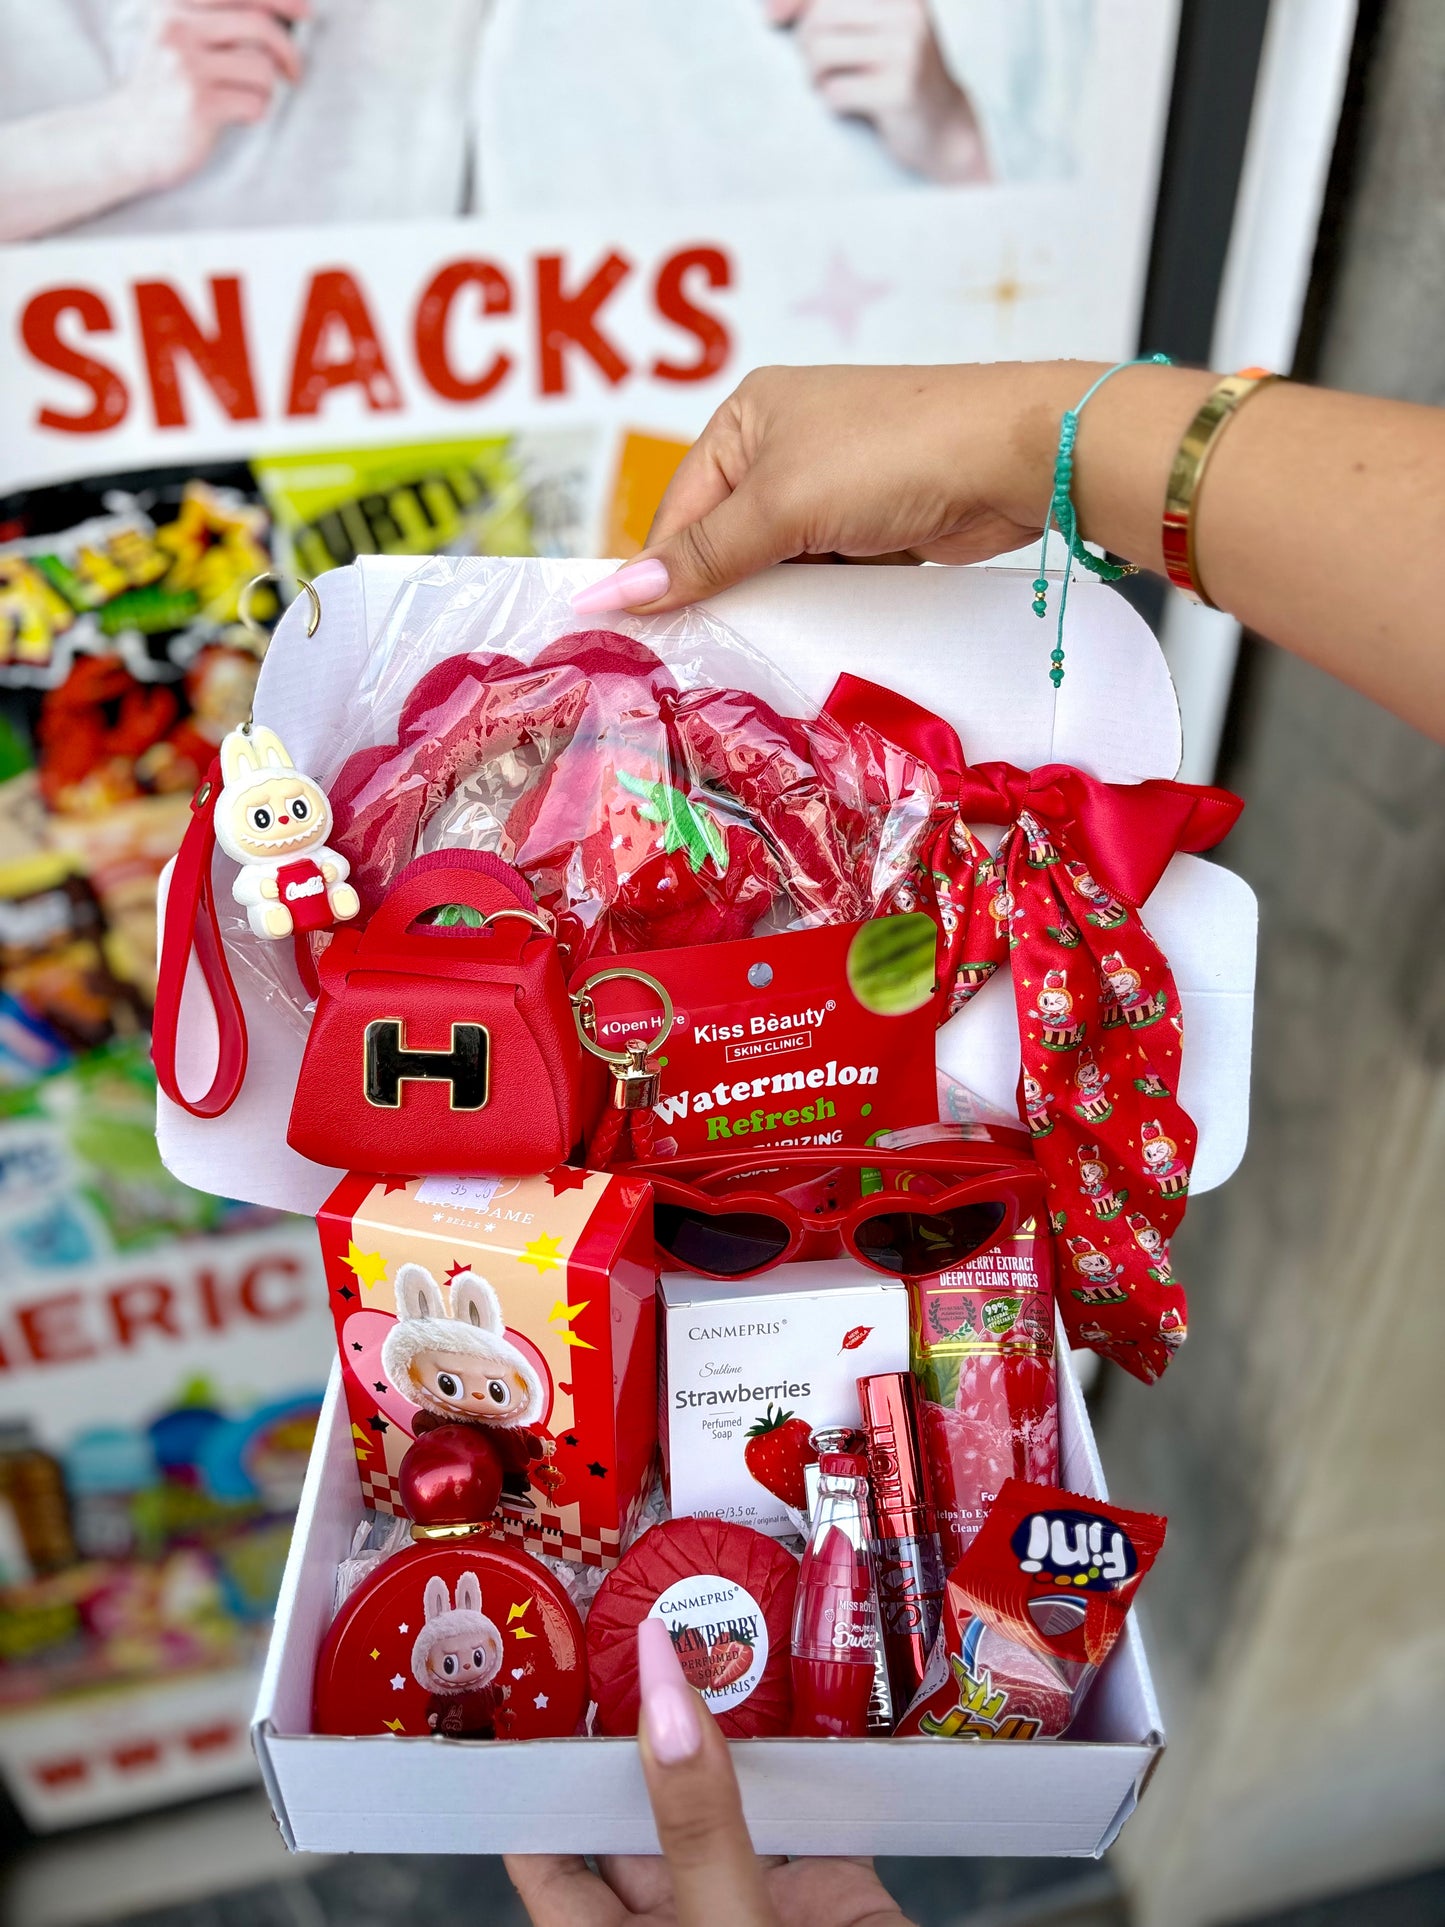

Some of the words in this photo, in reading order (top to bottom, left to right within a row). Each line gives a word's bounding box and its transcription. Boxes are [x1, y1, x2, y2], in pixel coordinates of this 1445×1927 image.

[20, 243, 737, 437] SNACKS
[609, 1020, 648, 1036] Open
[694, 1024, 744, 1044] Kiss
[733, 1041, 763, 1058] SKIN
[764, 1036, 804, 1053] CLINIC
[364, 1018, 490, 1112] H
[652, 1060, 879, 1125] Watermelon
[705, 1097, 836, 1141] Refresh
[996, 1256, 1034, 1271] EXTRACT
[940, 1271, 973, 1287] DEEPLY
[975, 1271, 1009, 1286] CLEANS
[1011, 1272, 1039, 1288] PORES
[984, 1301, 1008, 1315] 99%
[698, 1361, 742, 1378] Sublime
[675, 1380, 811, 1409] Strawberries
[702, 1417, 742, 1431] Perfumed
[712, 1430, 732, 1439] Soap
[960, 1509, 973, 1519] To
[839, 1599, 859, 1612] MISS
[673, 1615, 760, 1654] RAWBERRY
[681, 1650, 739, 1670] PERFUMED
[698, 1665, 726, 1680] SOAP
